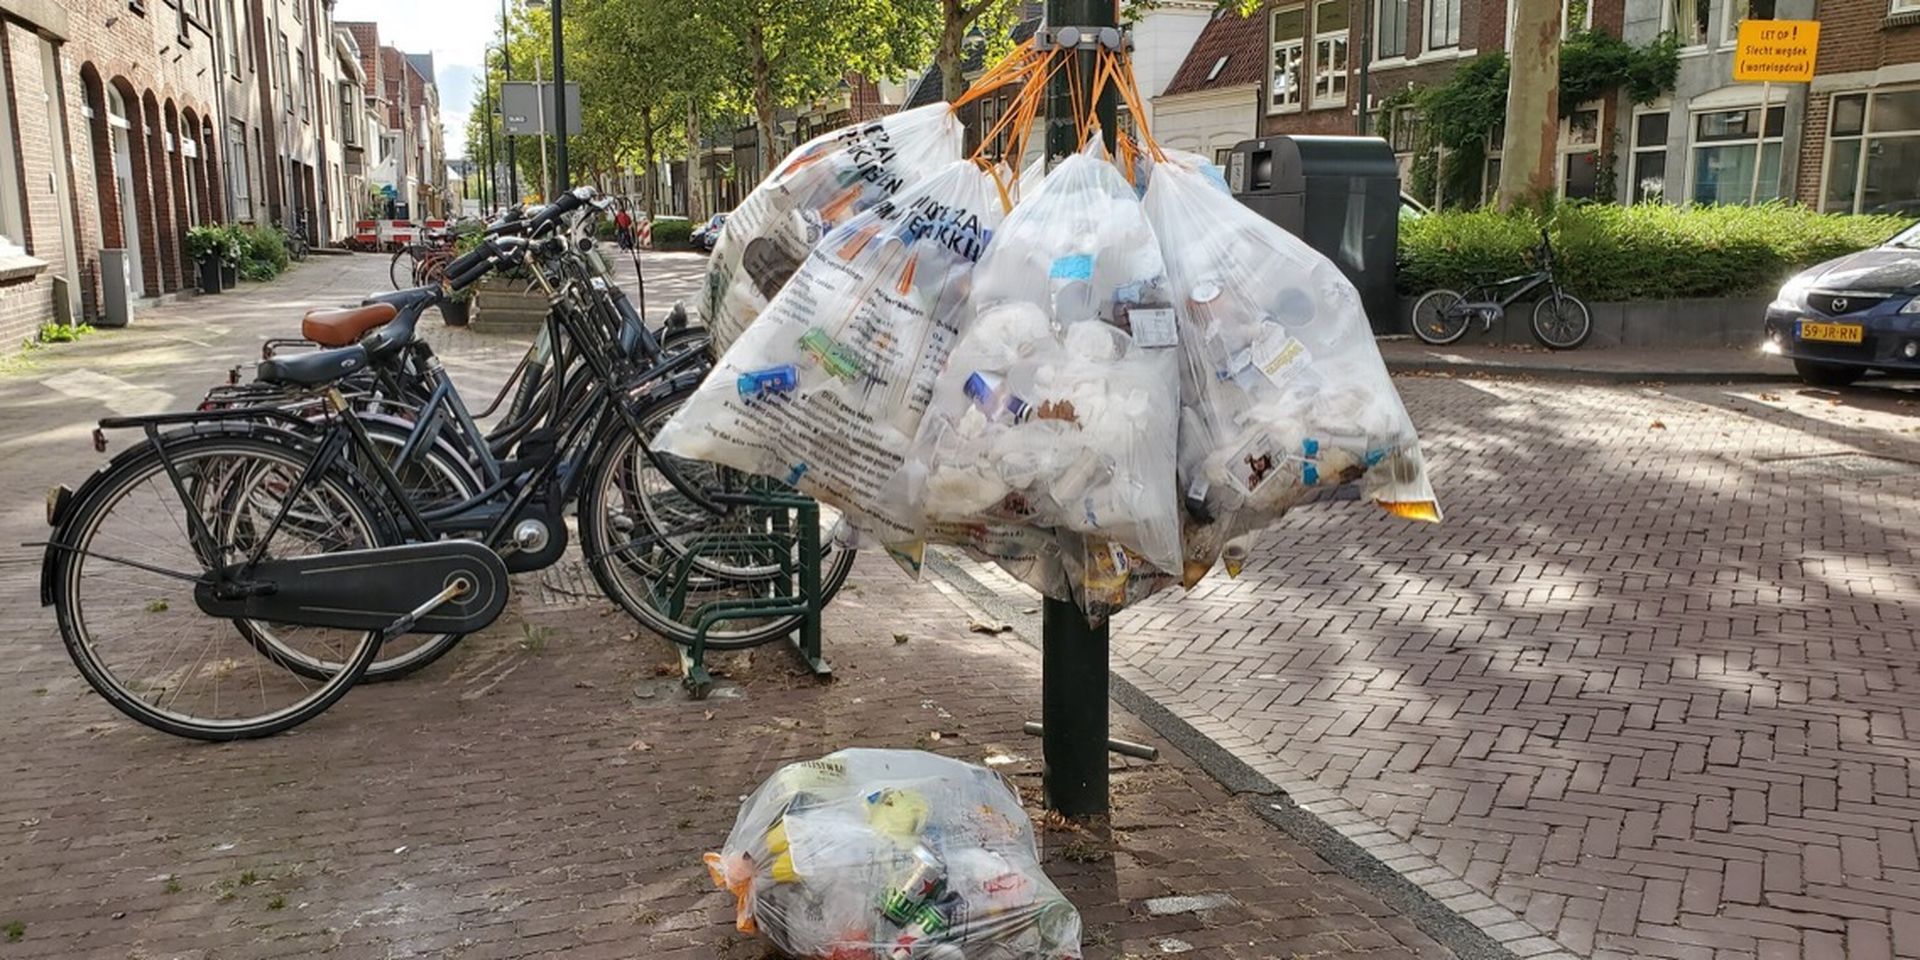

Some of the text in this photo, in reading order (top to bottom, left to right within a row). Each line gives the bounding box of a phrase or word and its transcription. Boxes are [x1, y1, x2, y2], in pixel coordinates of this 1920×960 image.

[1760, 30, 1775, 40] LET
[1777, 30, 1789, 40] OP
[1745, 45, 1807, 57] Slecht wegdek
